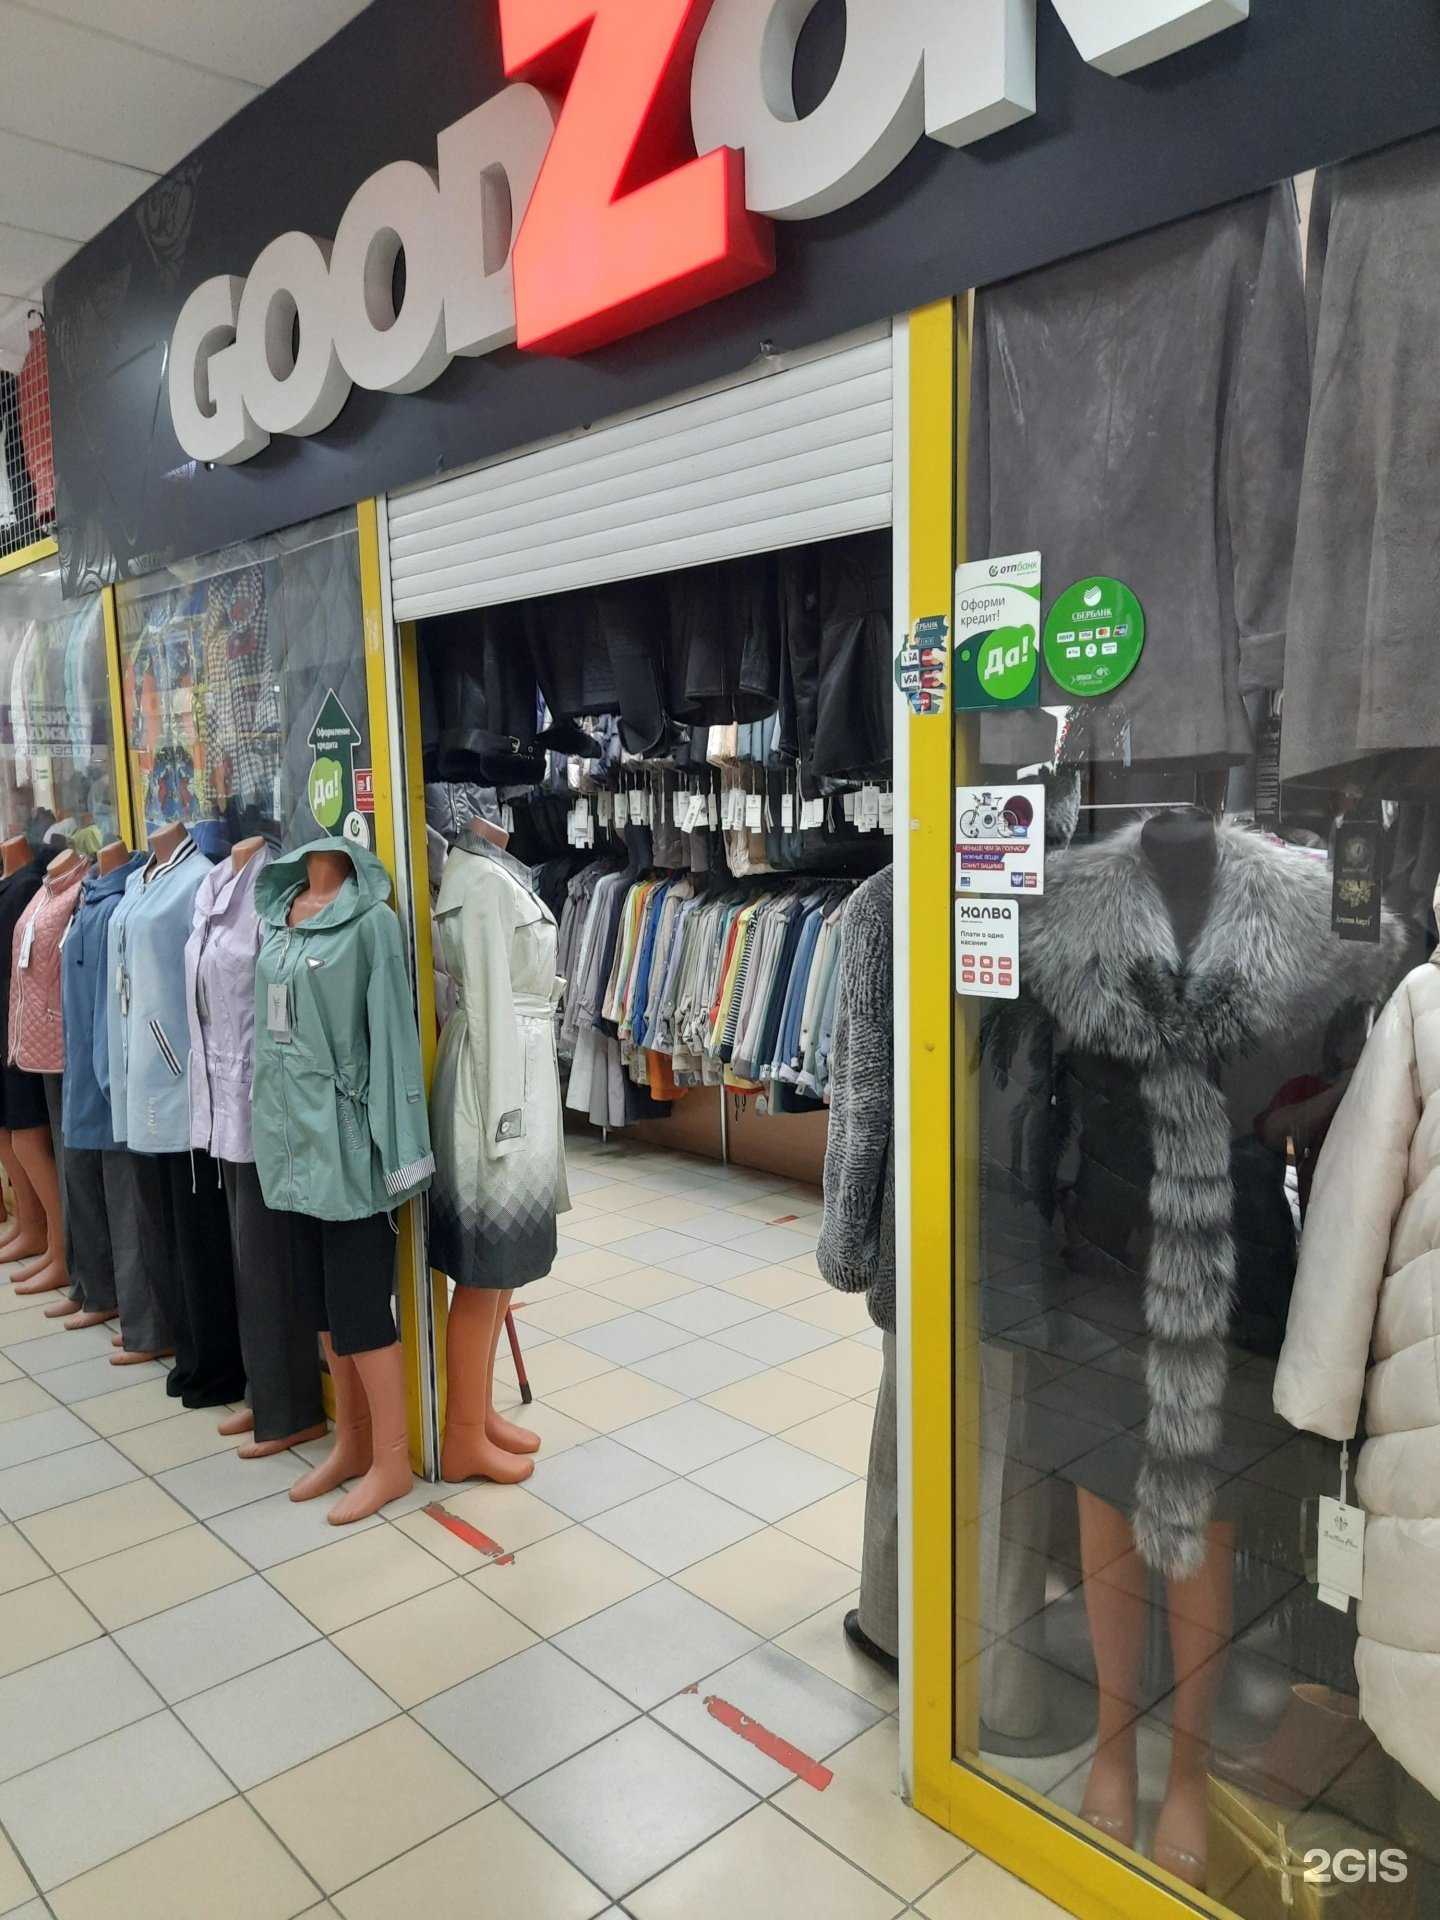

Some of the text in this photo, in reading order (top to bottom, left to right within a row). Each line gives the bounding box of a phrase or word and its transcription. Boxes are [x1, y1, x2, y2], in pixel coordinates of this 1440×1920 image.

[961, 597, 1006, 613] Оформи
[961, 609, 1001, 628] кредит!
[984, 636, 1029, 680] Да!
[315, 727, 351, 739] Оформление
[316, 741, 338, 752] кредита
[313, 769, 339, 810] Да!
[960, 930, 981, 938] Плати
